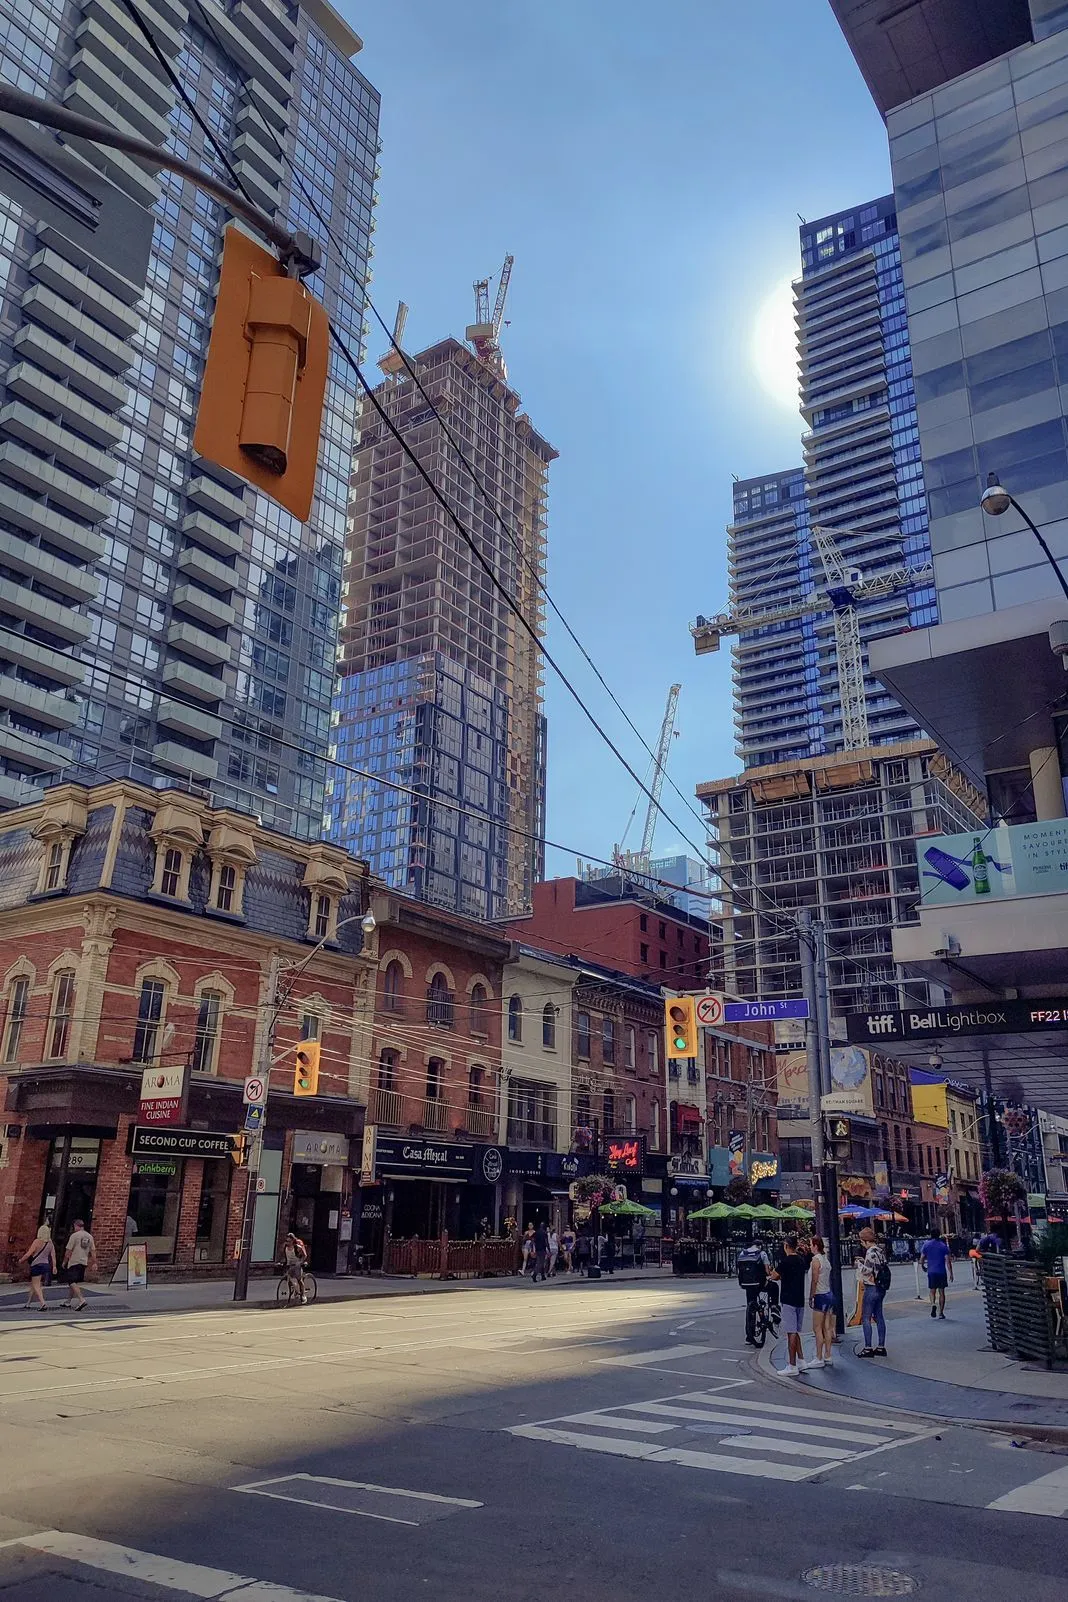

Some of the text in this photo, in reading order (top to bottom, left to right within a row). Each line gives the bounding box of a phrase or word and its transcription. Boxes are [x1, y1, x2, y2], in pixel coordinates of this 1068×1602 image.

[744, 1004, 776, 1017] John
[1030, 1010, 1061, 1022] FF22
[867, 1014, 897, 1034] tiff.
[145, 1075, 180, 1088] AROMA
[141, 1100, 179, 1110] FINE INDIAN
[146, 1110, 171, 1120] CUISINE
[140, 1135, 229, 1150] SECOND CUP COFFEE
[306, 1139, 340, 1153] AROMA
[402, 1146, 448, 1163] Casa Mezcal
[138, 1163, 176, 1176] pinkberry
